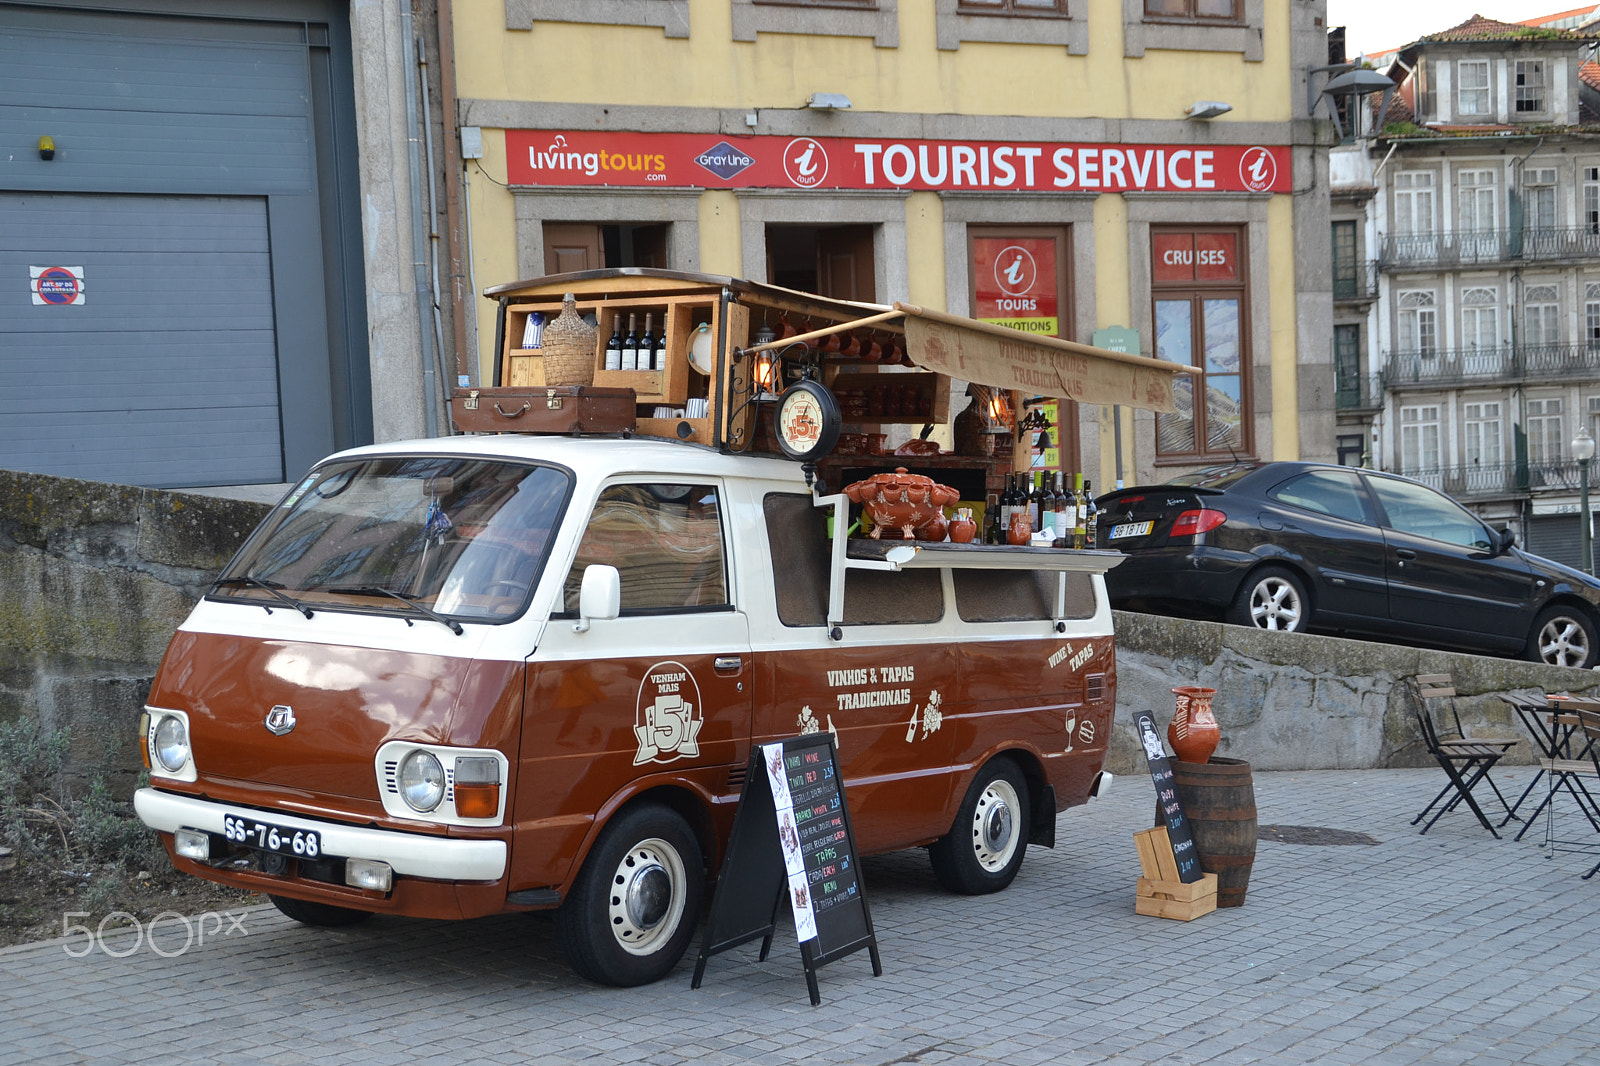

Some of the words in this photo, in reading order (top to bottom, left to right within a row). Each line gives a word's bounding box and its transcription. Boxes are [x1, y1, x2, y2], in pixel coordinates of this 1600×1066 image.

[854, 143, 1042, 187] TOURIST
[1052, 147, 1215, 189] SERVICE
[1163, 249, 1226, 265] CRUISES
[995, 298, 1037, 311] TOURS
[989, 321, 1052, 332] MOTIONS
[796, 415, 810, 437] 5
[1048, 646, 1068, 669] WINE
[1069, 643, 1094, 672] TAPAS
[650, 672, 686, 684] VENHAM
[827, 668, 868, 687] VINHOS
[870, 667, 878, 684] &
[880, 666, 915, 683] TAPAS
[658, 683, 680, 693] MAIS
[837, 688, 911, 710] TRADICIONAIS
[653, 694, 684, 752] 5
[225, 816, 319, 856] SS-76-68
[815, 847, 837, 865] TAPAS
